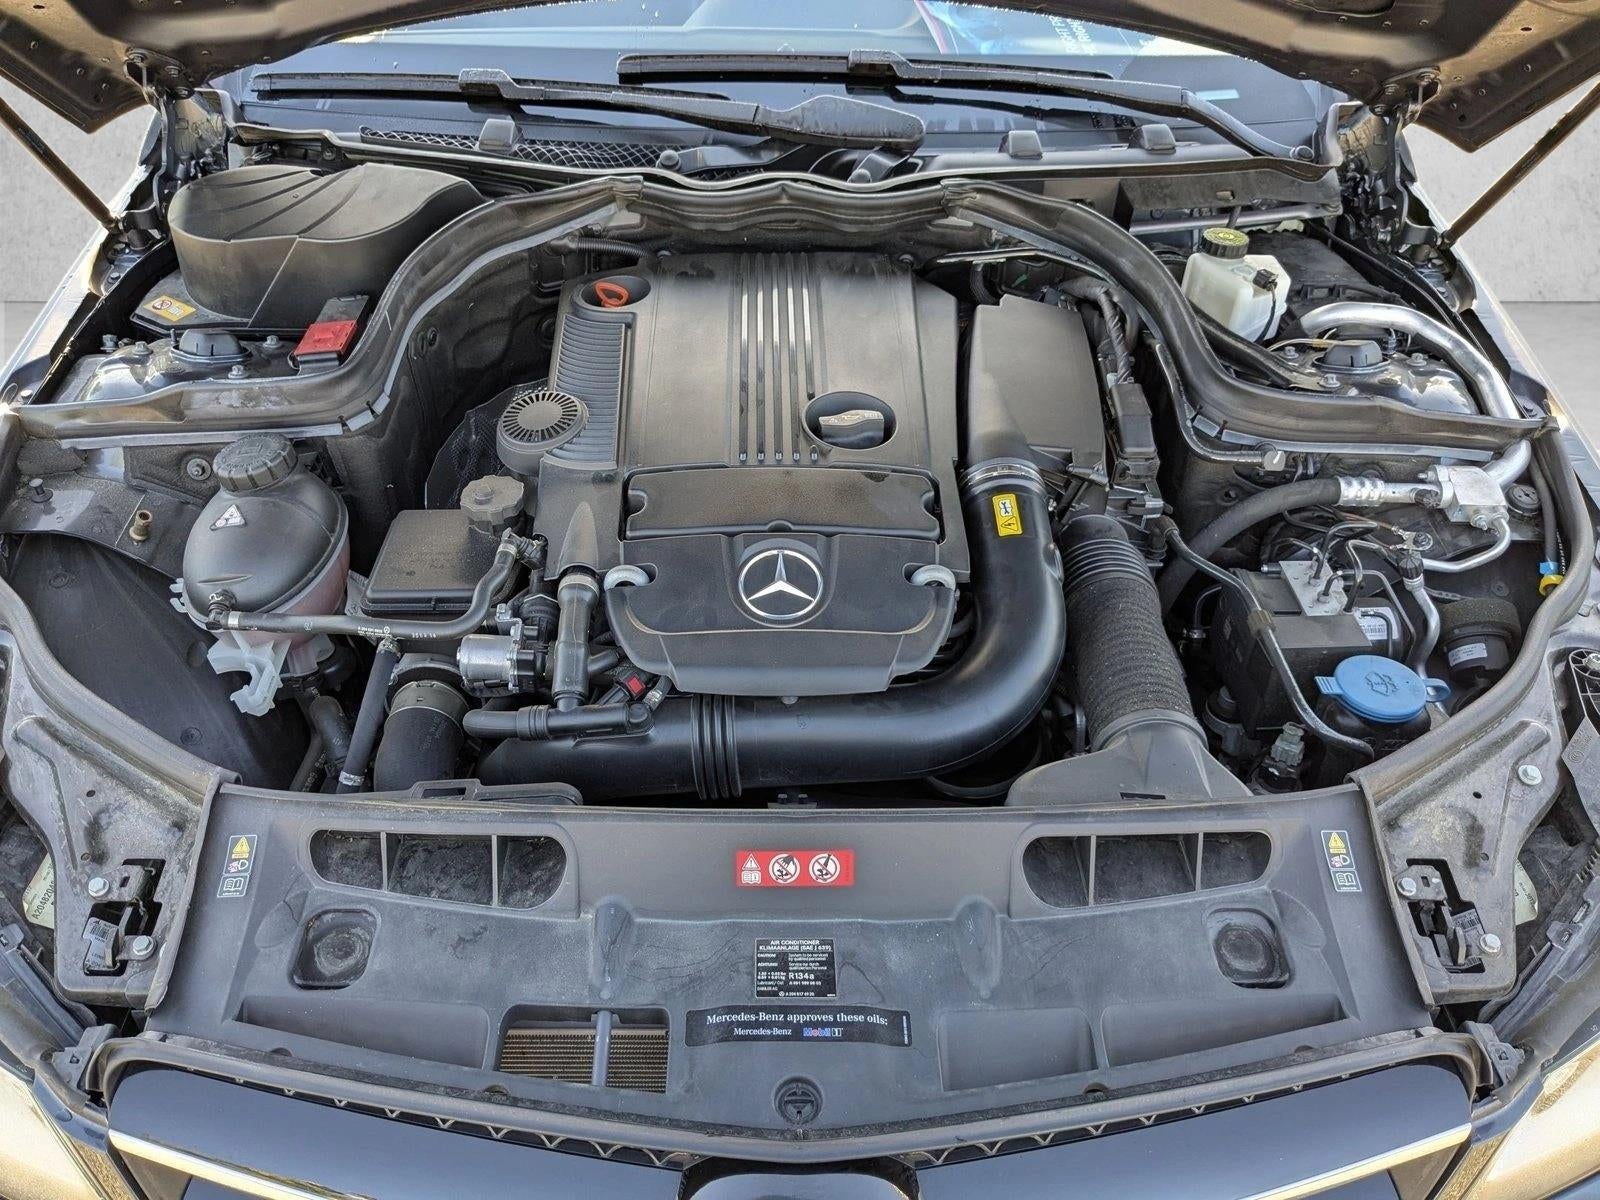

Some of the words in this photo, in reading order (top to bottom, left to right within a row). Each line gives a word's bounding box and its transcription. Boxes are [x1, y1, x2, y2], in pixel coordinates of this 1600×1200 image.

[788, 972, 815, 980] R134a
[706, 1011, 785, 1025] Mercedes-Benz
[786, 1012, 834, 1024] approves
[836, 1012, 865, 1022] these
[733, 1027, 792, 1036] Mercedes-Benz
[802, 1027, 831, 1037] Mobil
